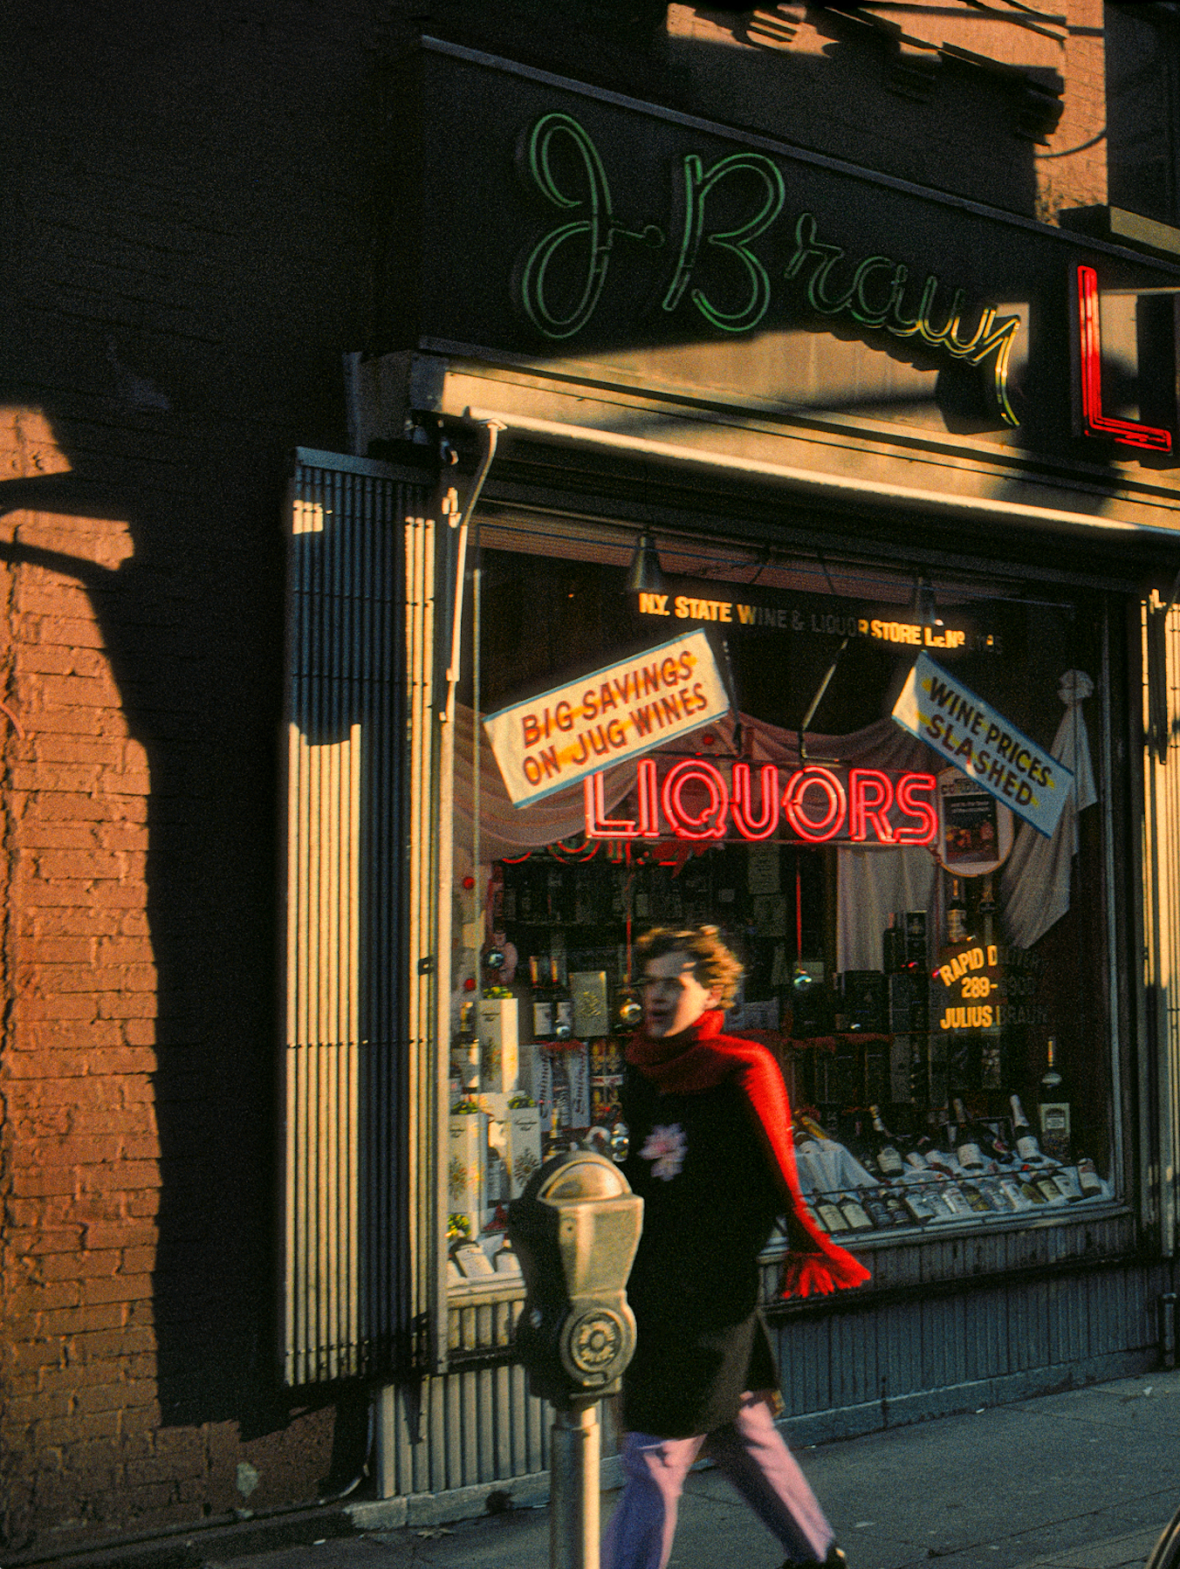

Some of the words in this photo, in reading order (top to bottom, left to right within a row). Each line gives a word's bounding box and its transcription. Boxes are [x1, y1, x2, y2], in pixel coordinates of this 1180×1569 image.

[674, 596, 732, 623] STATE
[736, 604, 787, 628] WINE
[811, 614, 871, 638] LIQUOR
[871, 619, 922, 645] STORE
[521, 701, 574, 749] BIG
[582, 650, 693, 721] SAVINGS
[522, 745, 563, 787] ON
[572, 718, 627, 766] JUG
[629, 682, 708, 738] WINES
[930, 676, 985, 736] WINE
[987, 726, 1053, 788] PRICES
[584, 758, 939, 845] LIQUORS
[926, 714, 1033, 806] SLASHED
[939, 947, 985, 987] RAPID
[940, 1005, 993, 1030] JULIUS
